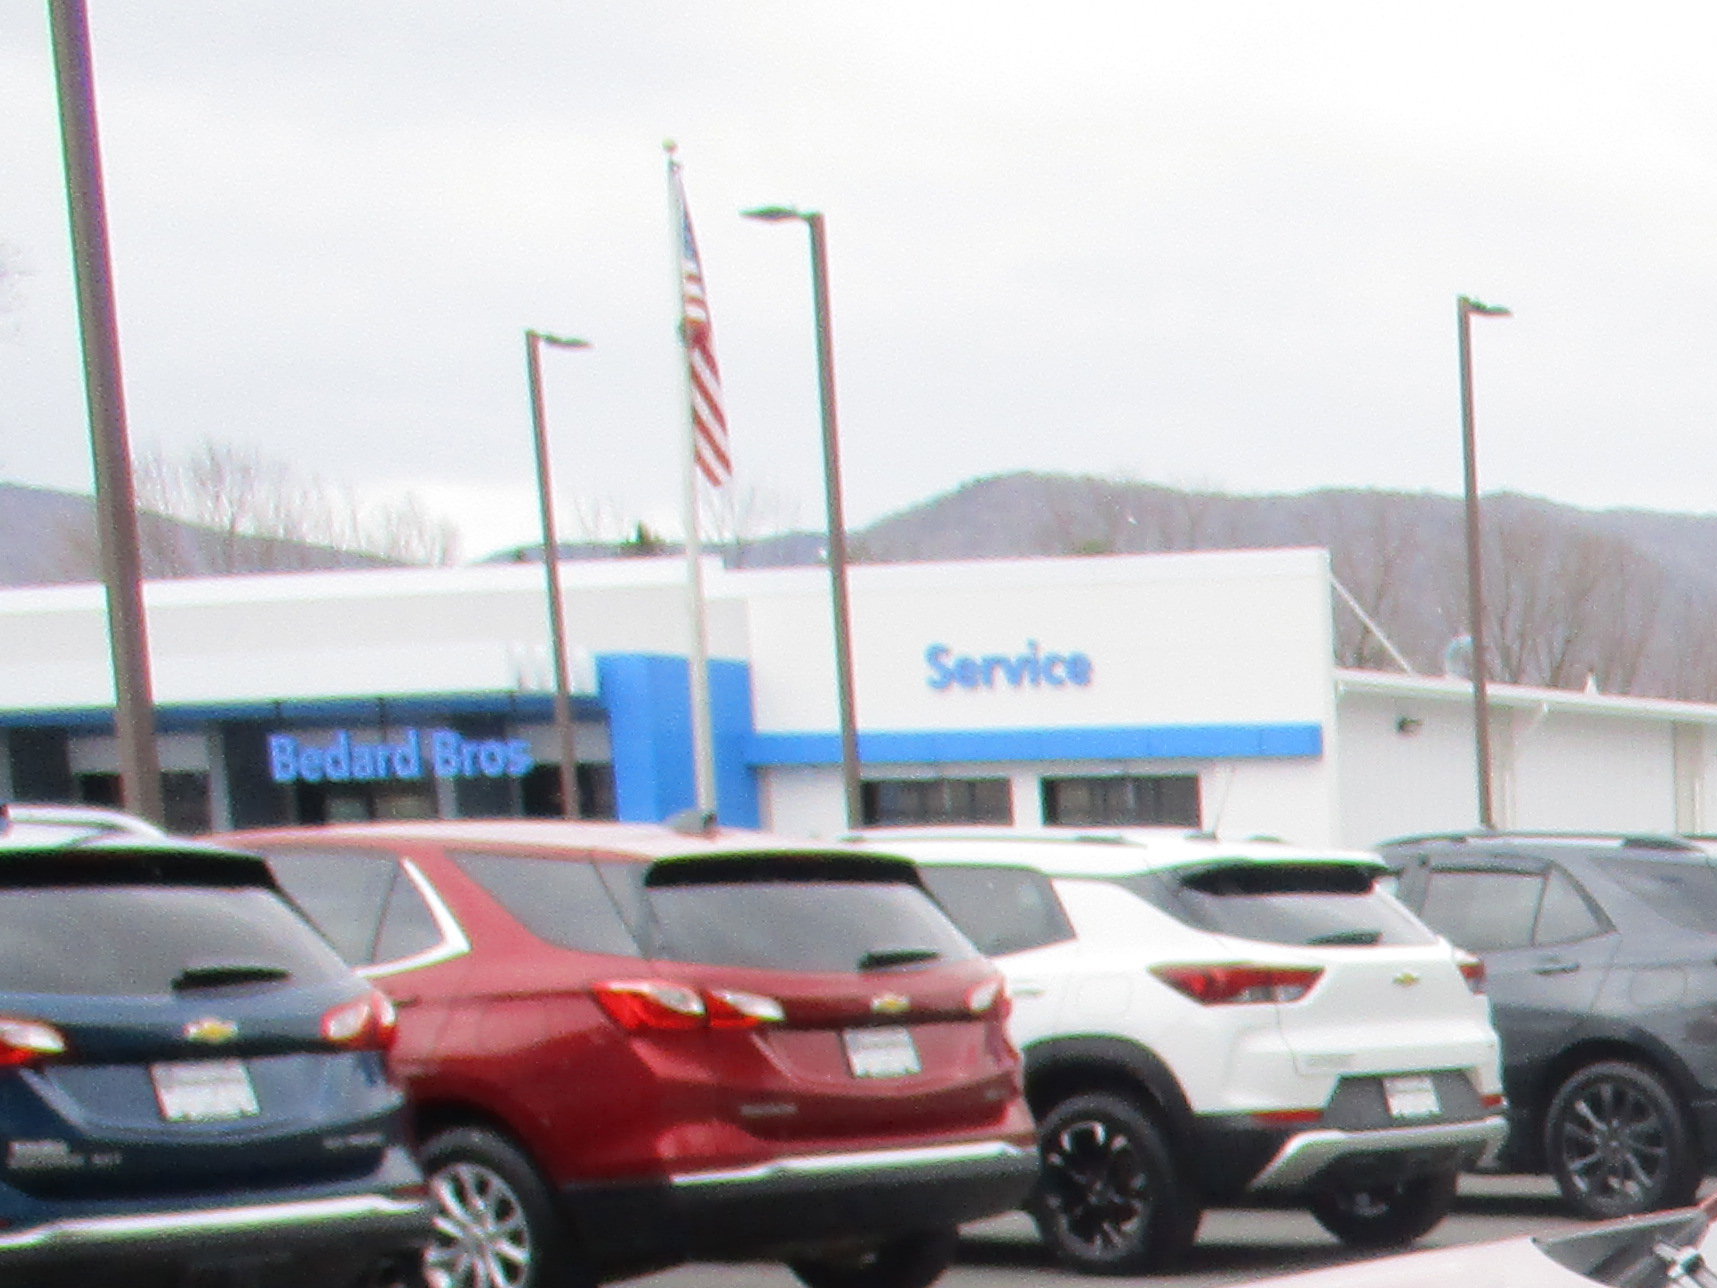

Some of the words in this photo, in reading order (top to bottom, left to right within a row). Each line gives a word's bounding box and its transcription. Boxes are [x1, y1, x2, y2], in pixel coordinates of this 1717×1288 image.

[924, 637, 1093, 690] Service
[268, 727, 421, 782] Bedard
[431, 727, 536, 778] Bros
